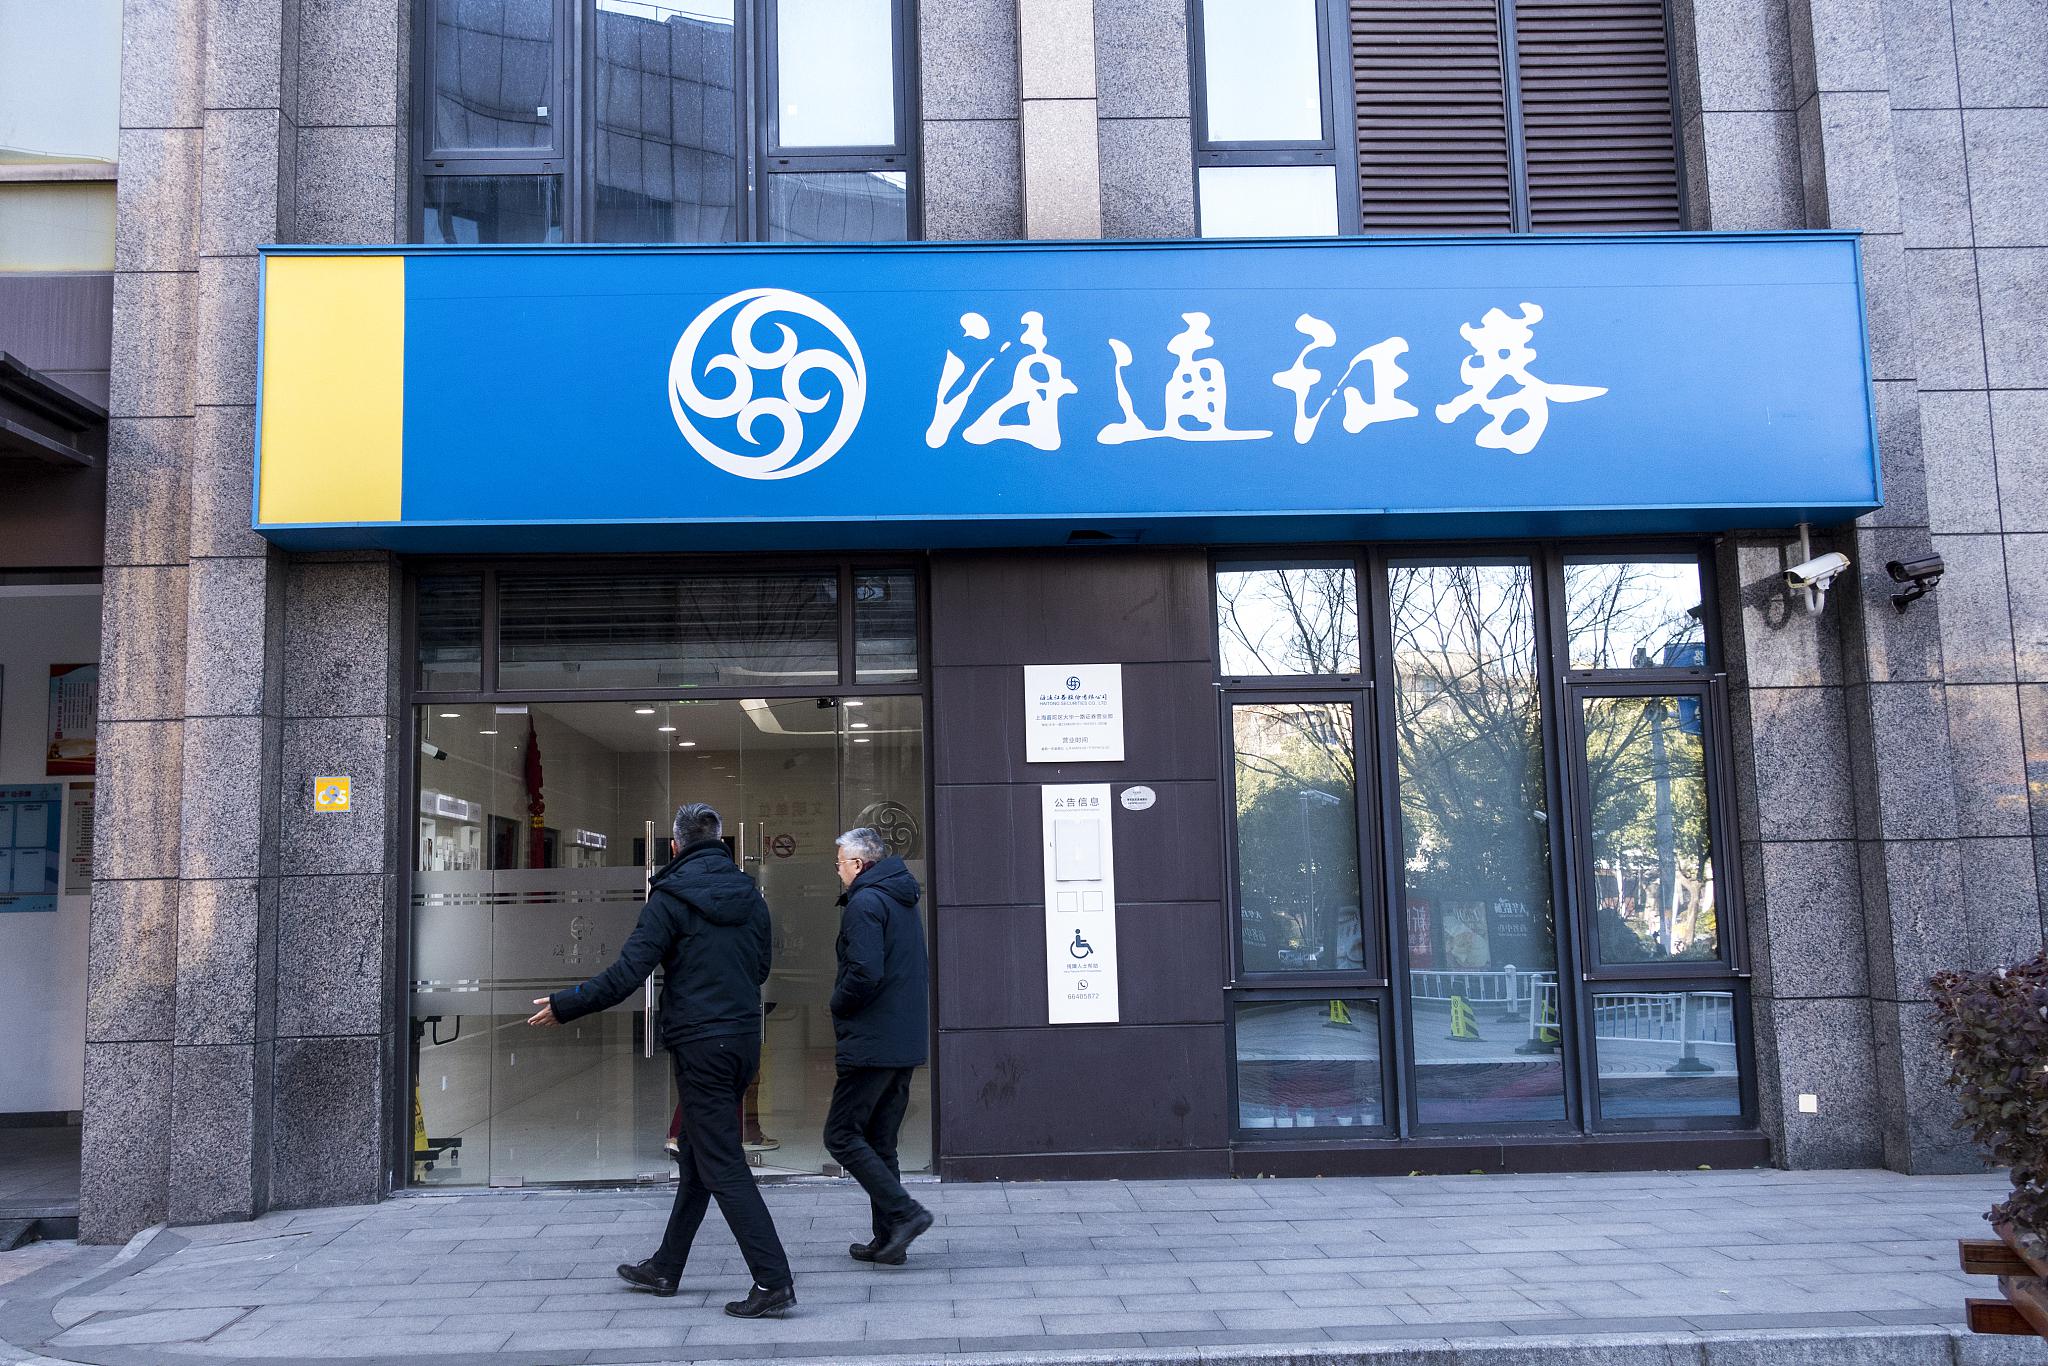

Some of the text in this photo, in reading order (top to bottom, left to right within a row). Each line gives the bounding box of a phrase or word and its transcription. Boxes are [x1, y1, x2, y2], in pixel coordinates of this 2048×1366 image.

[926, 302, 1609, 455] 海通证券
[1062, 736, 1089, 744] 营业时间
[1054, 796, 1099, 807] 公告信息
